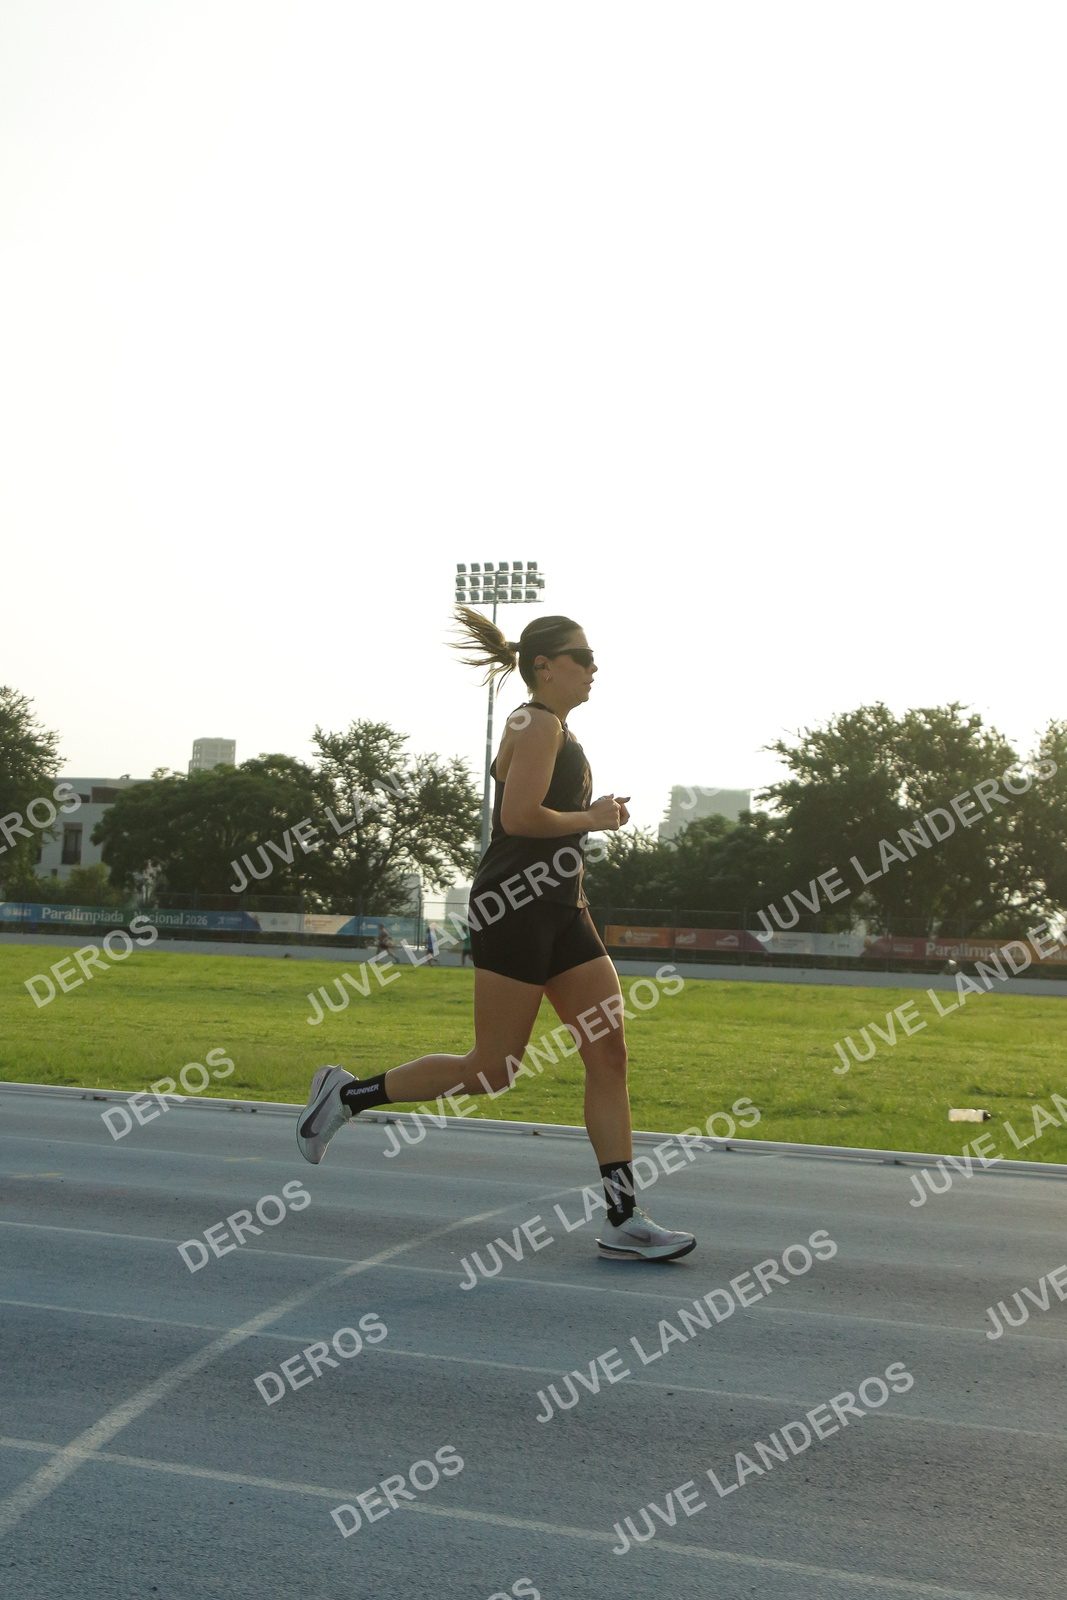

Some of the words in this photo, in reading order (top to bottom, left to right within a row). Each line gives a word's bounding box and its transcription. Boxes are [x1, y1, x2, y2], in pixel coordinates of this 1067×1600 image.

[41, 907, 124, 924] Paralimpiada
[134, 911, 184, 925] Ncional
[185, 915, 208, 926] 2026
[345, 1083, 380, 1096] RUNNER
